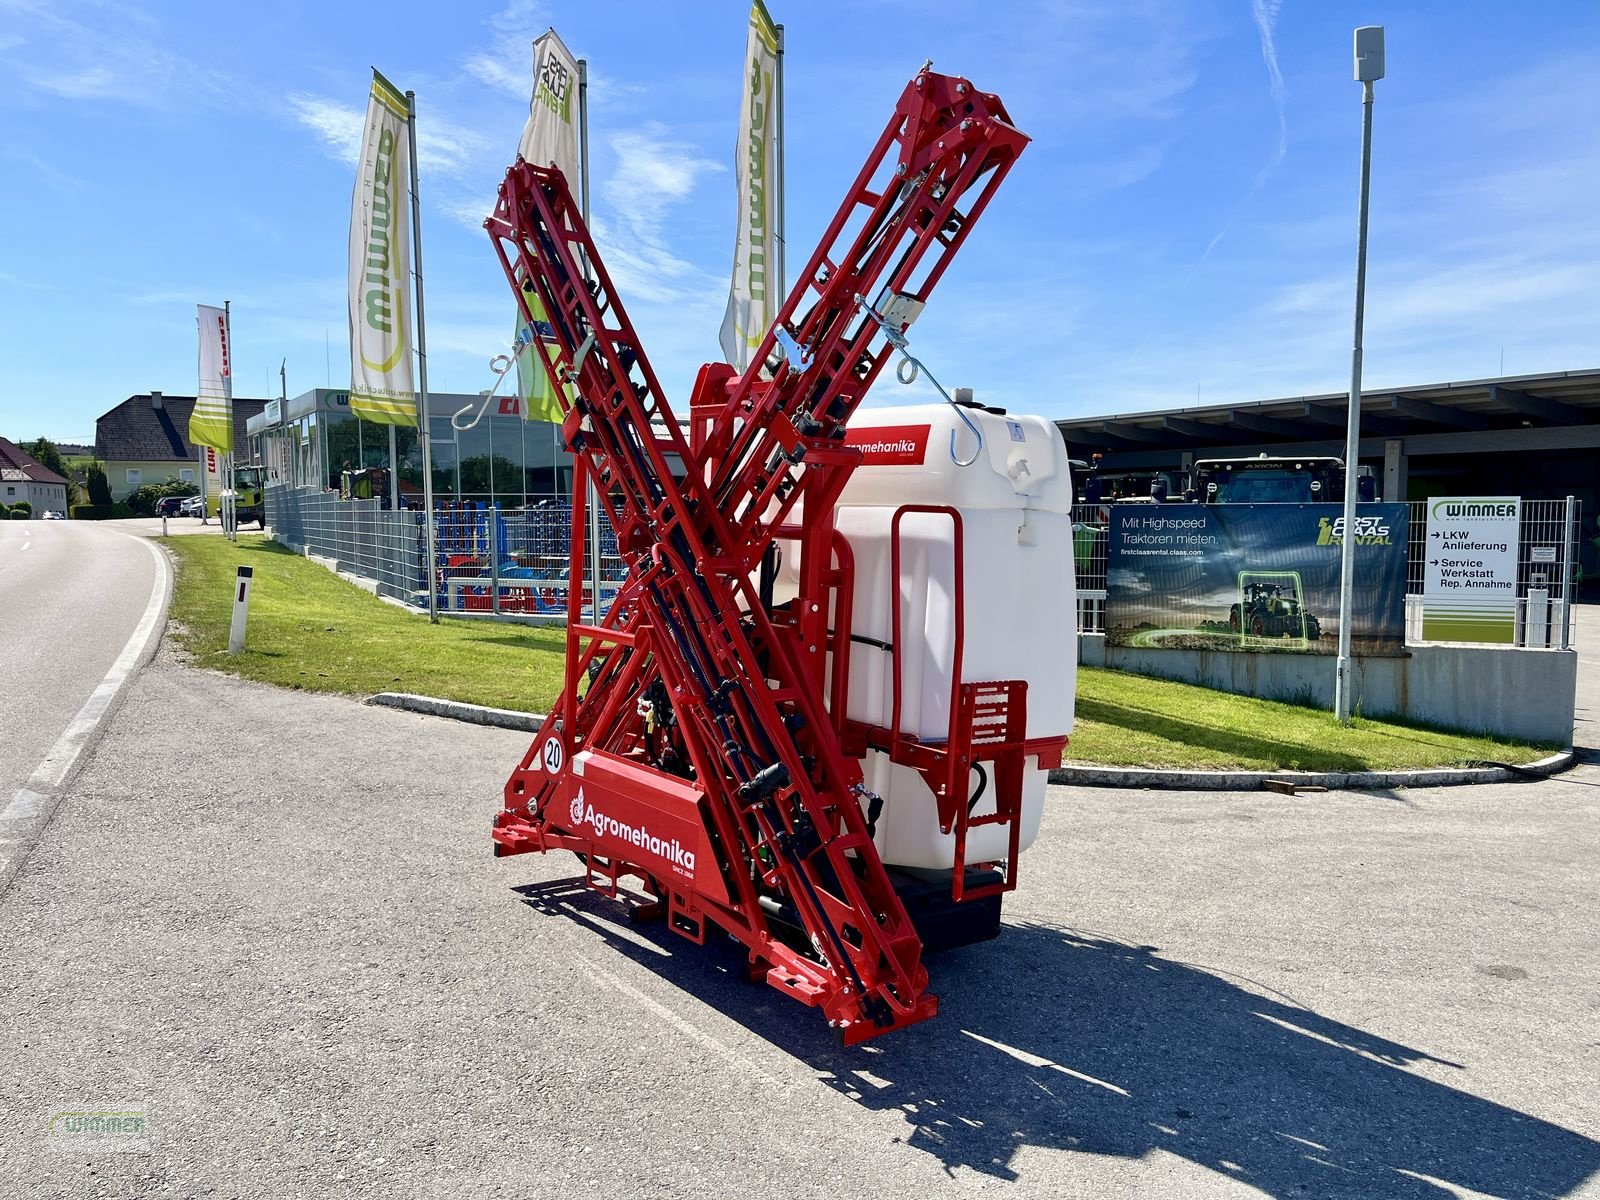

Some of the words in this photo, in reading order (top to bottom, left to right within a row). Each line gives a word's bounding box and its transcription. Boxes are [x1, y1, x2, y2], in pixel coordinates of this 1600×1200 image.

[207, 446, 217, 473] CLAA
[1446, 504, 1516, 517] WIMMER
[1122, 518, 1139, 528] Mit
[1142, 517, 1206, 530] Highspeed
[1333, 517, 1383, 527] FRST
[1331, 526, 1390, 536] CAAS
[1442, 531, 1469, 540] LKW
[1121, 533, 1173, 544] Traktoren
[1176, 533, 1219, 544] mieten.
[1328, 535, 1392, 545] RNTAL
[1442, 541, 1508, 552] Anlieferung
[1441, 559, 1483, 568] Service
[1441, 569, 1494, 578] Werkstatt
[1440, 580, 1462, 589] Rep.
[1465, 580, 1512, 589] Annahme
[546, 740, 560, 769] 20
[584, 803, 695, 870] Agromehanika
